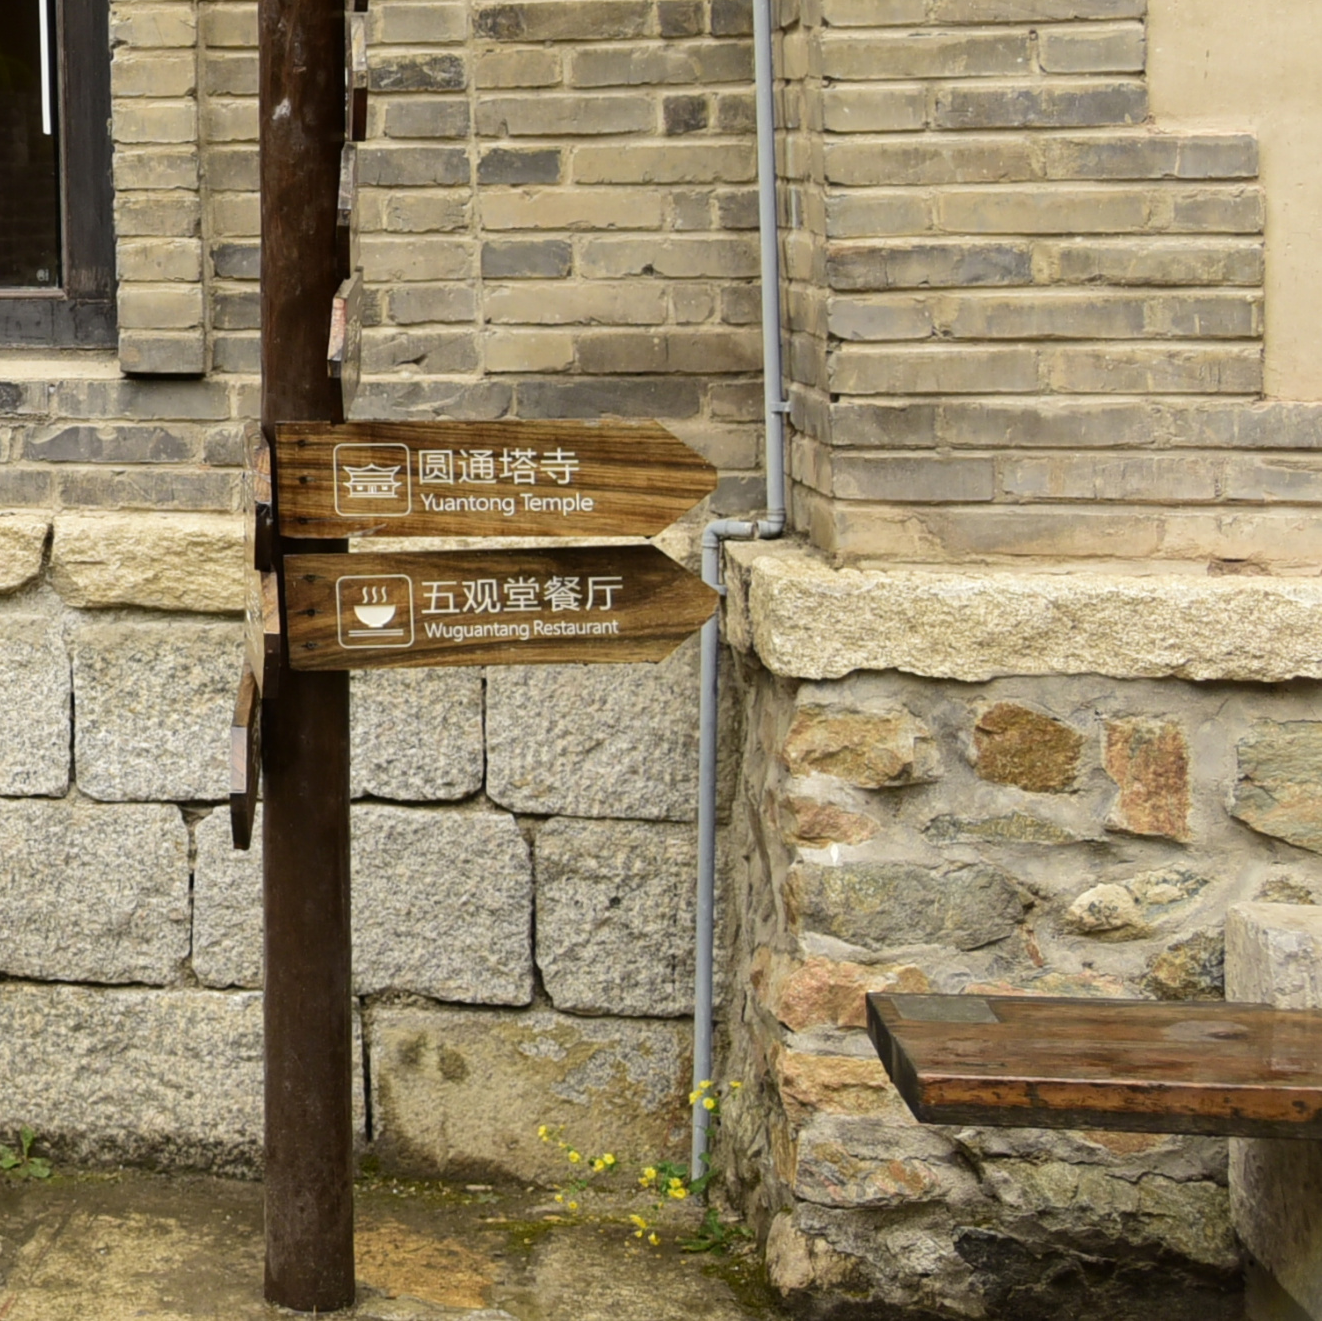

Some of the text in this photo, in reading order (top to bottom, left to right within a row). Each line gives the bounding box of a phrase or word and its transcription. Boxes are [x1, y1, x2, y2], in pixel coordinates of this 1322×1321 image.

[417, 447, 581, 485] 圆通塔寺
[420, 492, 594, 516] Yuantong Temple
[420, 575, 624, 615] 五观堂餐厅
[424, 618, 619, 641] Wuguantang Restaurant
